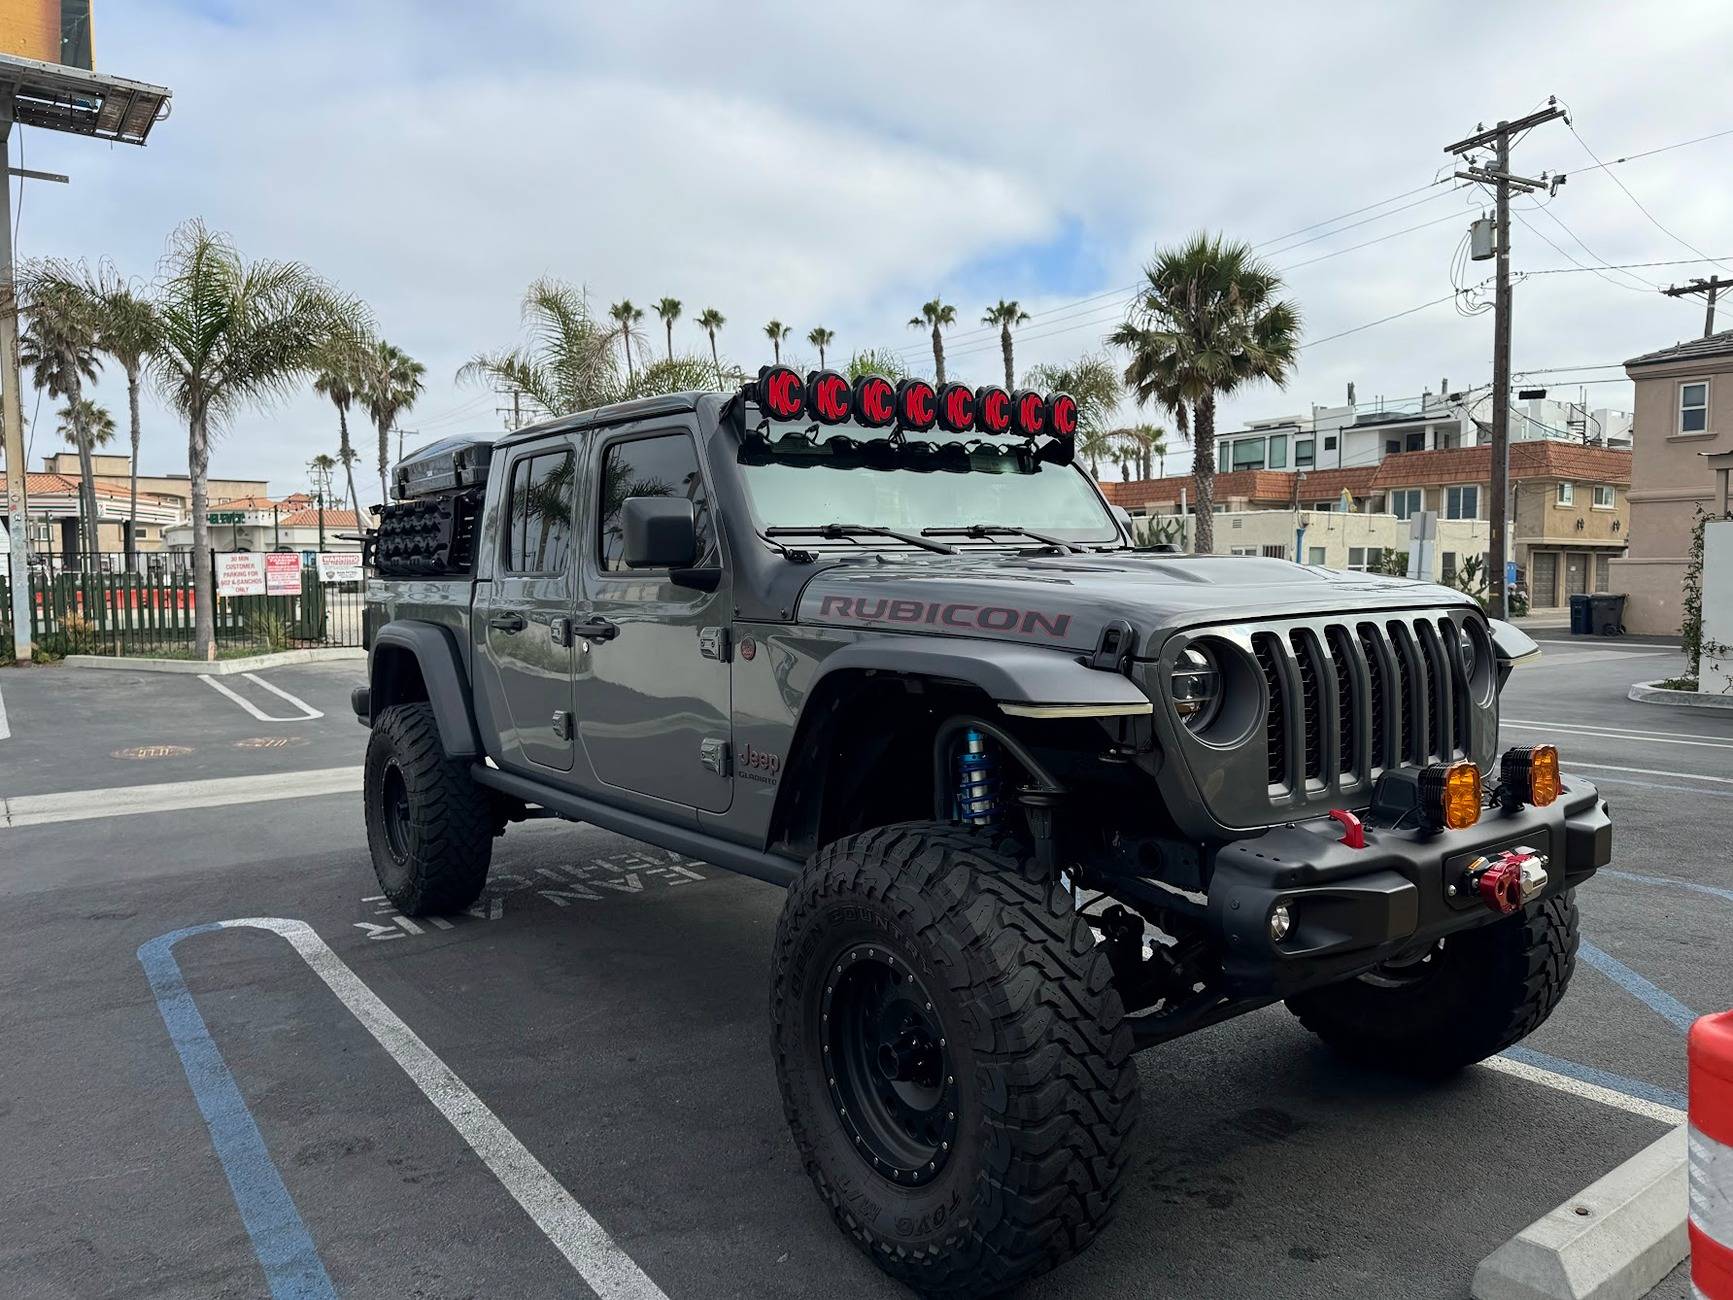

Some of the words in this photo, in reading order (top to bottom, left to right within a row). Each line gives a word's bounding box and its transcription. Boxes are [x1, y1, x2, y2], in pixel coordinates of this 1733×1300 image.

[769, 371, 800, 416] KC
[817, 375, 848, 420] KC
[863, 379, 893, 421] KC
[906, 384, 934, 427] KC
[947, 387, 973, 429] KC
[985, 388, 1010, 430] KC
[1020, 394, 1043, 432] KC
[1054, 396, 1076, 435] KC
[820, 595, 1072, 638] RUBICON
[738, 744, 781, 777] Jeep
[738, 771, 777, 786] GLADIATO
